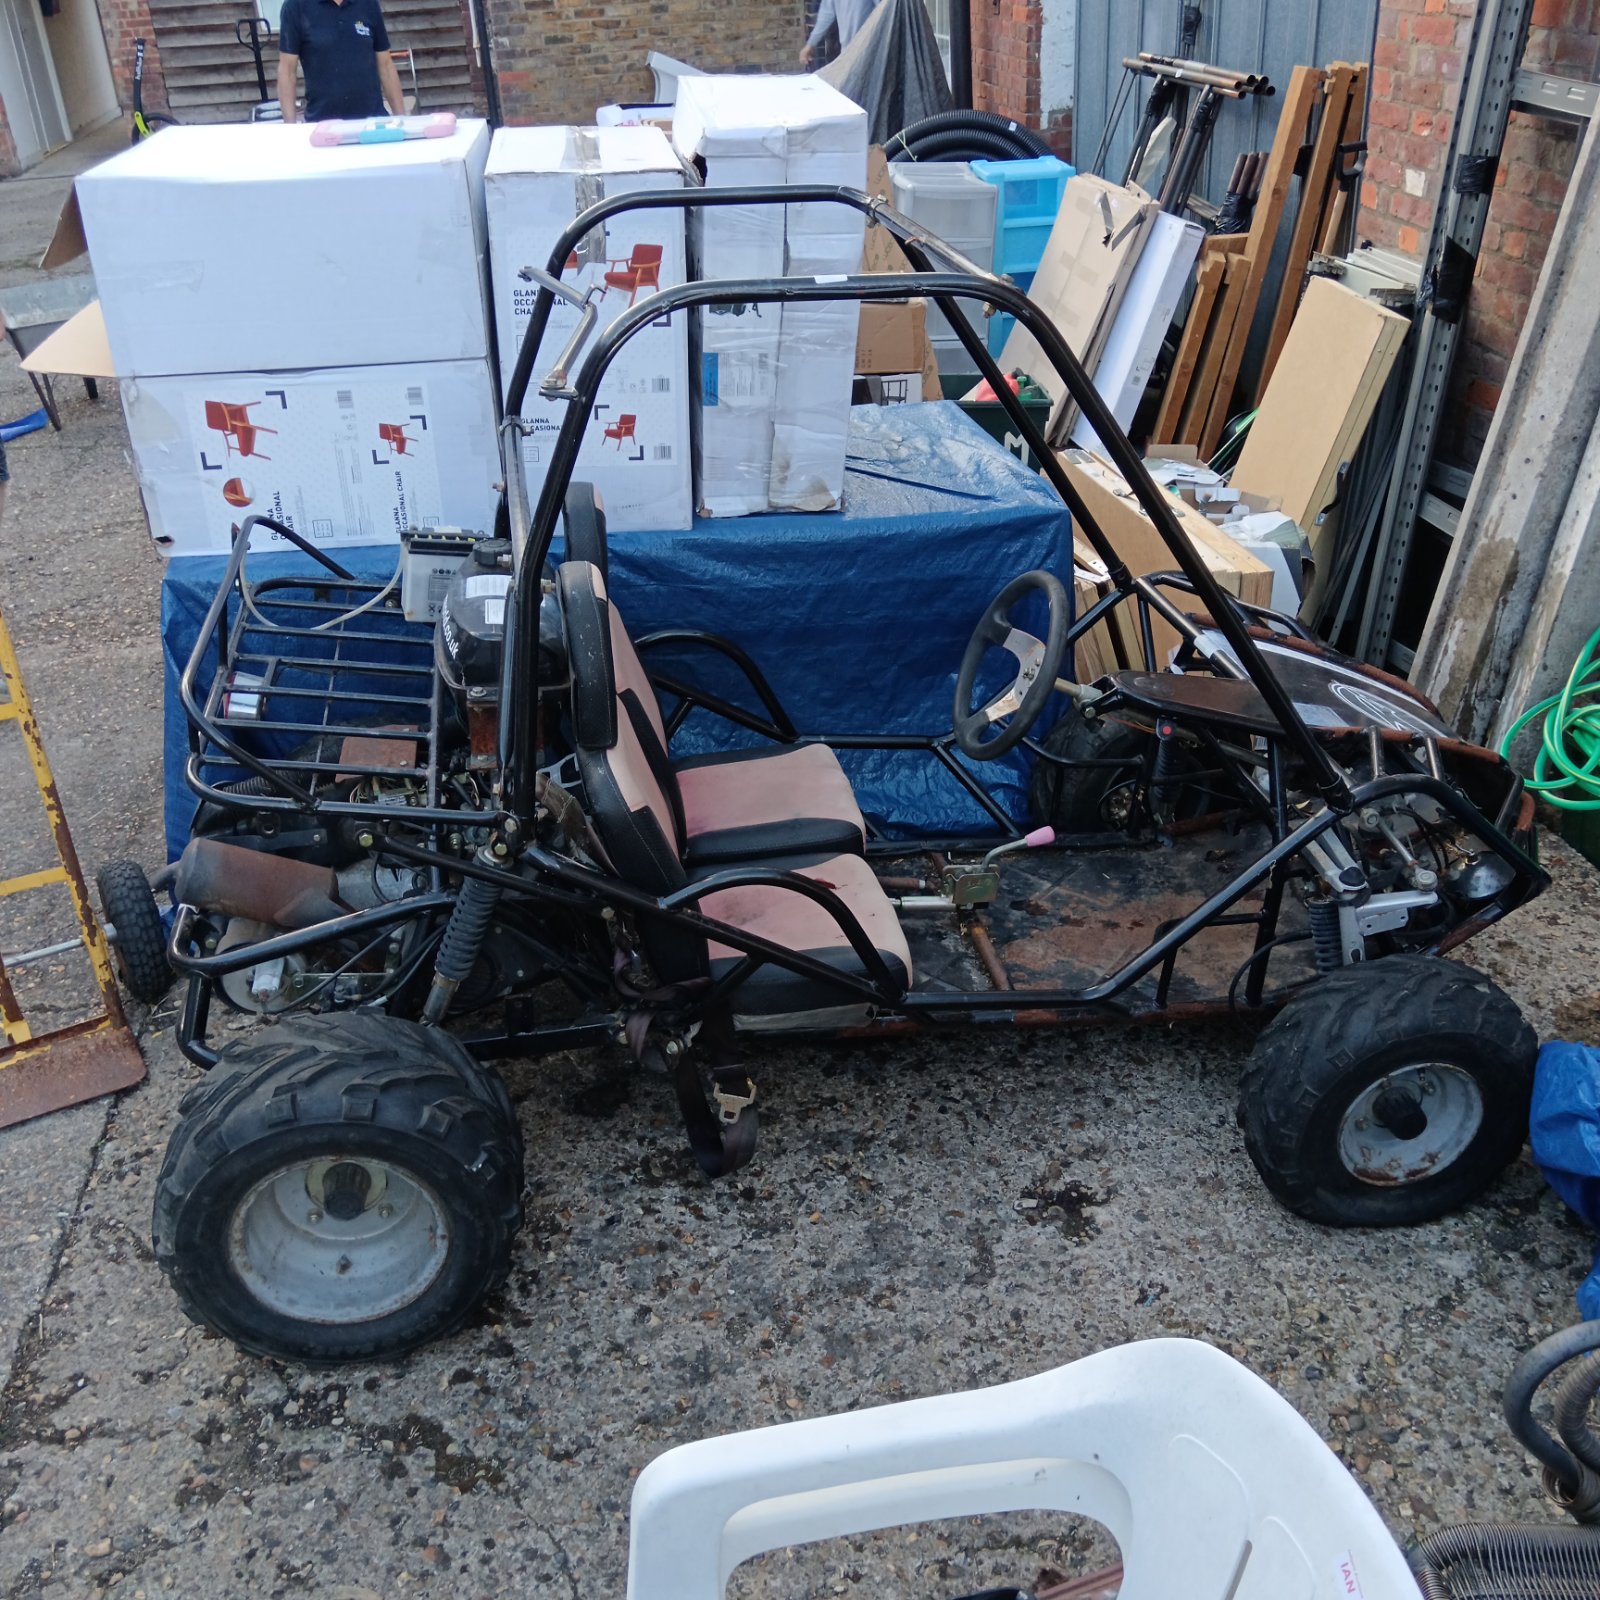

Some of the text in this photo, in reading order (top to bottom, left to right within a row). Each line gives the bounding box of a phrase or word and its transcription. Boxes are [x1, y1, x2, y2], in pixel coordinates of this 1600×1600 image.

[514, 298, 568, 306] OCCANAL
[395, 470, 404, 491] CHAIR
[267, 508, 278, 540] GLNA
[1341, 1562, 1355, 1594] IAN
